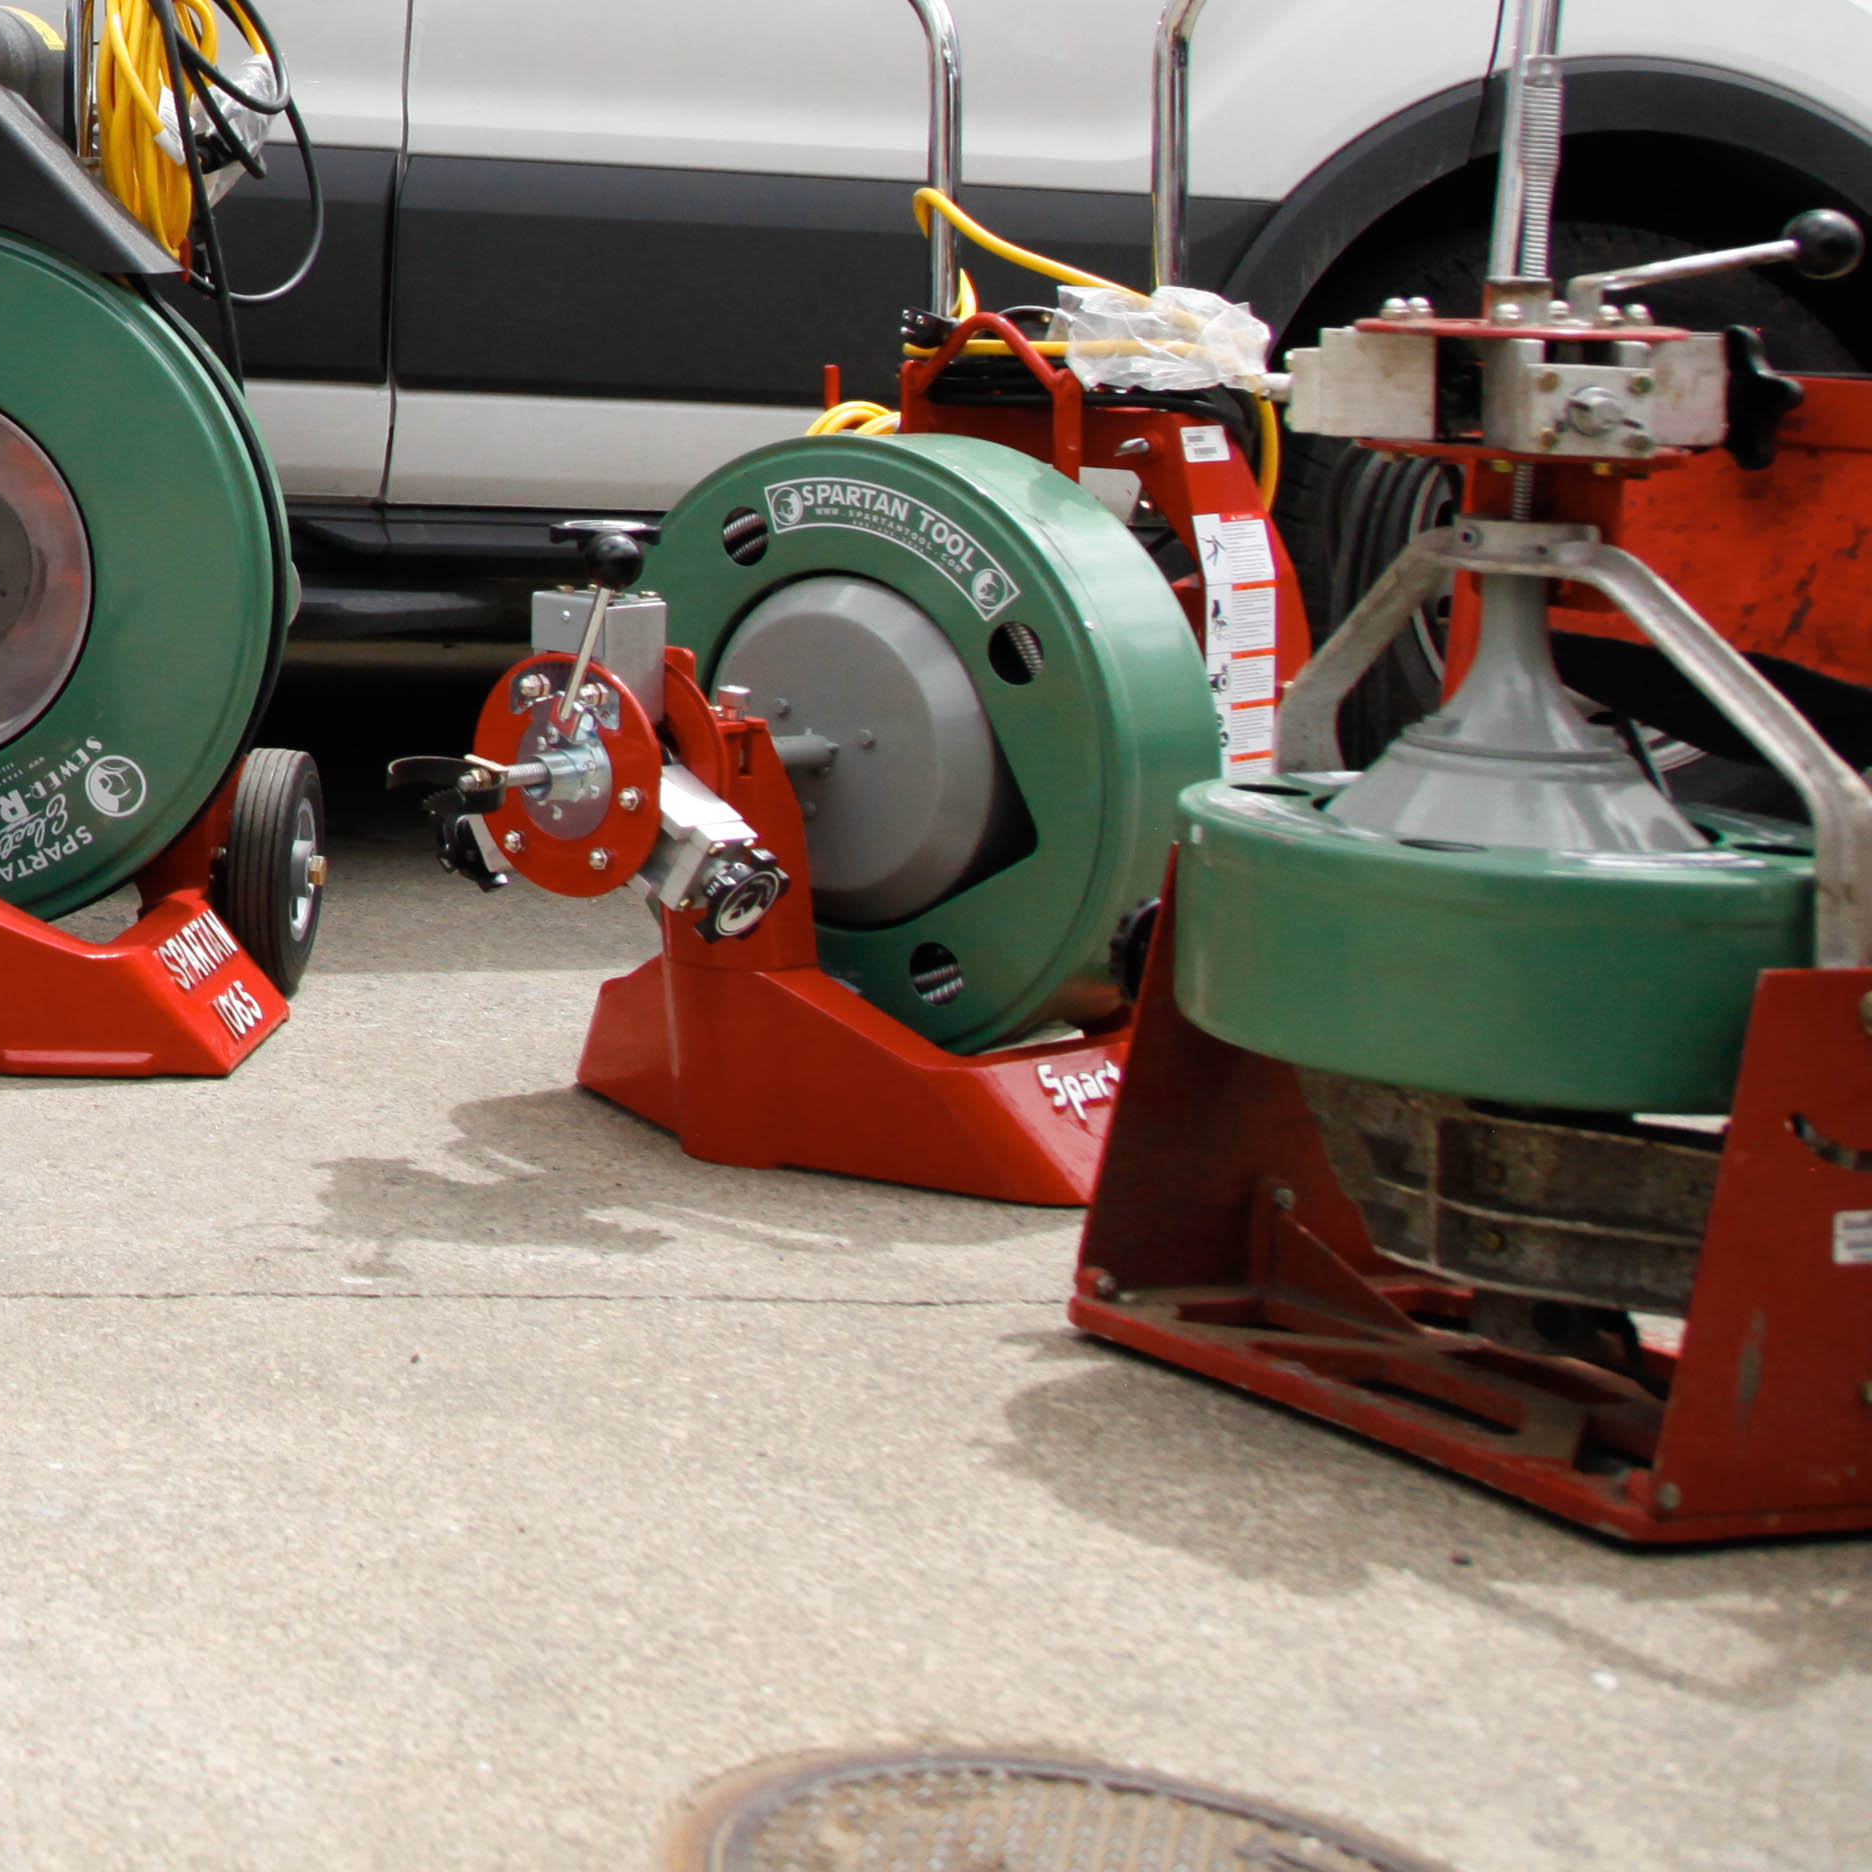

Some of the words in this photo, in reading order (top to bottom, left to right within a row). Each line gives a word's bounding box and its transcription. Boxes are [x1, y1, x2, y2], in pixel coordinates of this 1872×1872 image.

[802, 483, 910, 522] SPARTAN
[919, 509, 976, 572] TOOL
[156, 908, 239, 991] SPARTAN
[211, 979, 264, 1041] 1065
